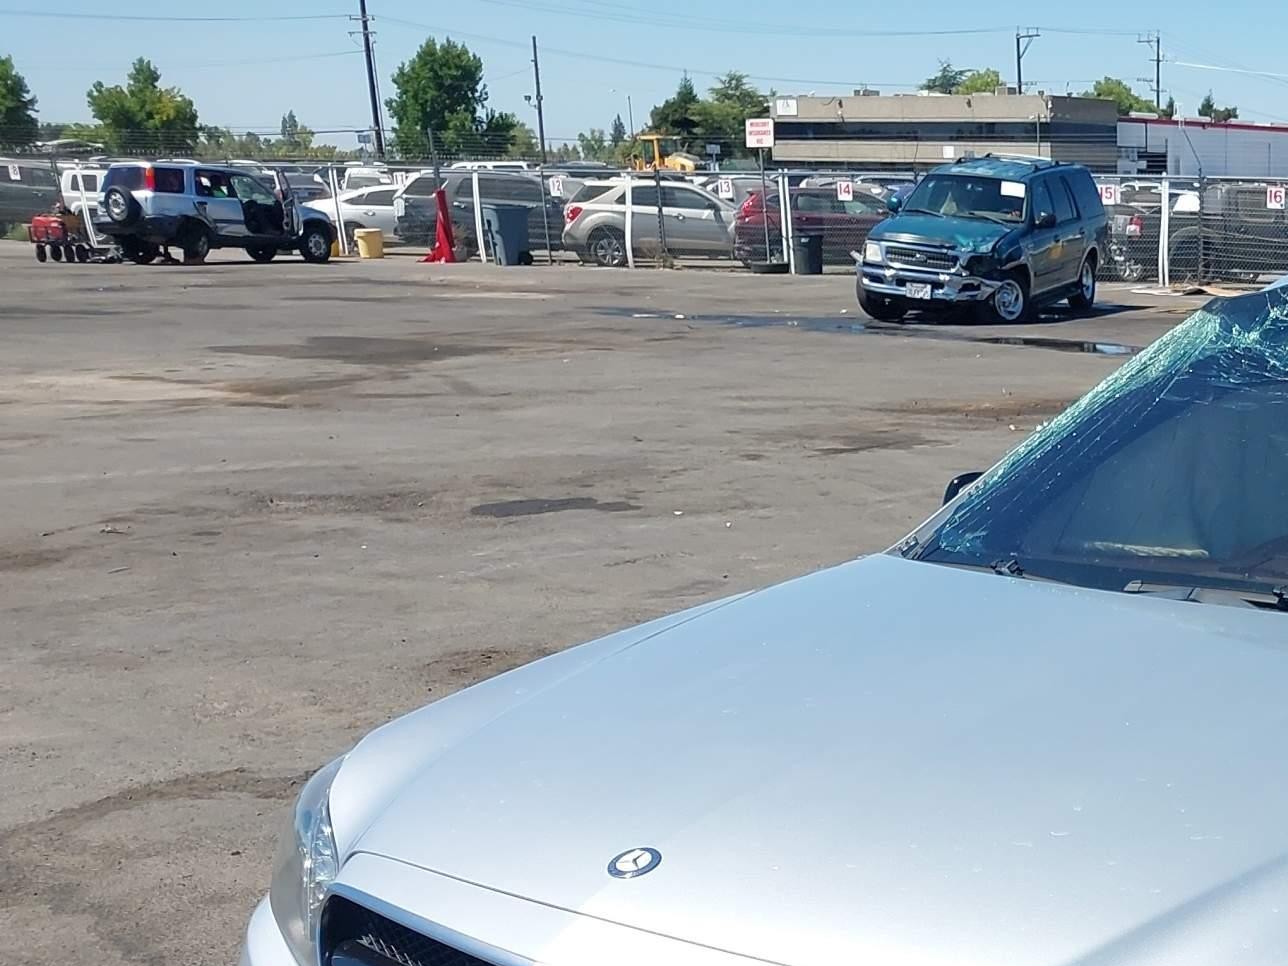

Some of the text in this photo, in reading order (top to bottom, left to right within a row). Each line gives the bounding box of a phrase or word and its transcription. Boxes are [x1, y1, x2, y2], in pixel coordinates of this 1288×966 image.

[719, 181, 731, 193] 13
[839, 184, 851, 196] 14
[1269, 189, 1283, 204] 16
